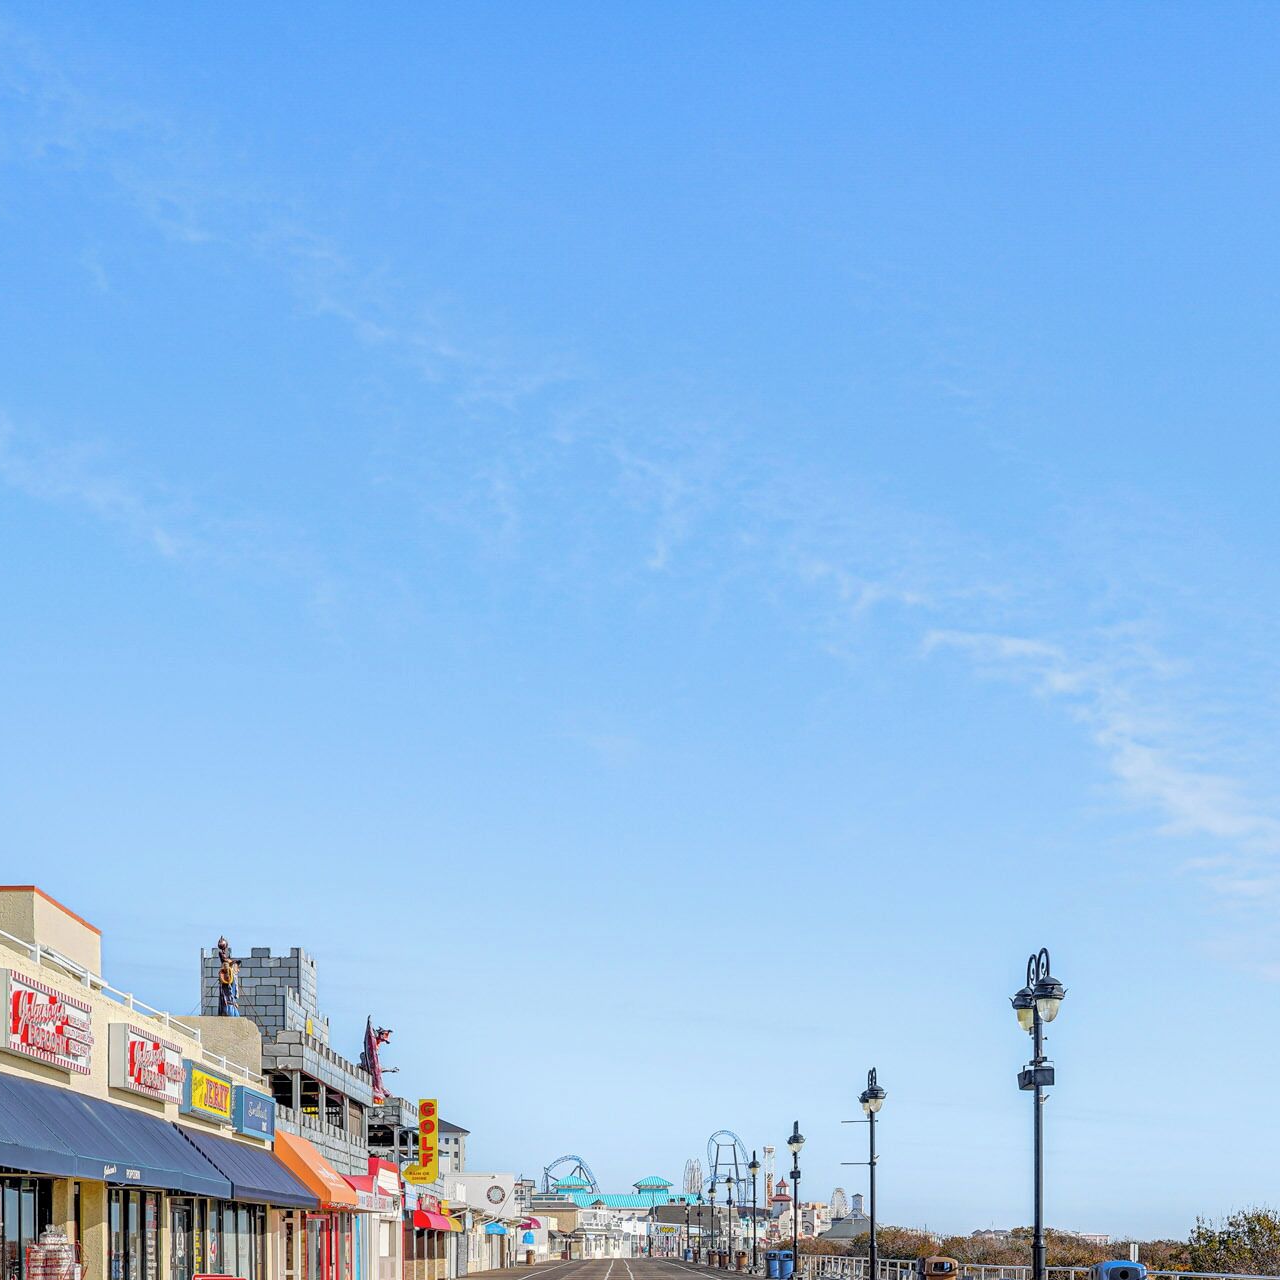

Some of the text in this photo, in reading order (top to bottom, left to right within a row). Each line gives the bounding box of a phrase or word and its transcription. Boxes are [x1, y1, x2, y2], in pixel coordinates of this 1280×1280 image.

[28, 1024, 67, 1056] POPCORN
[205, 1078, 230, 1112] JERKY
[420, 1101, 436, 1168] GOLF
